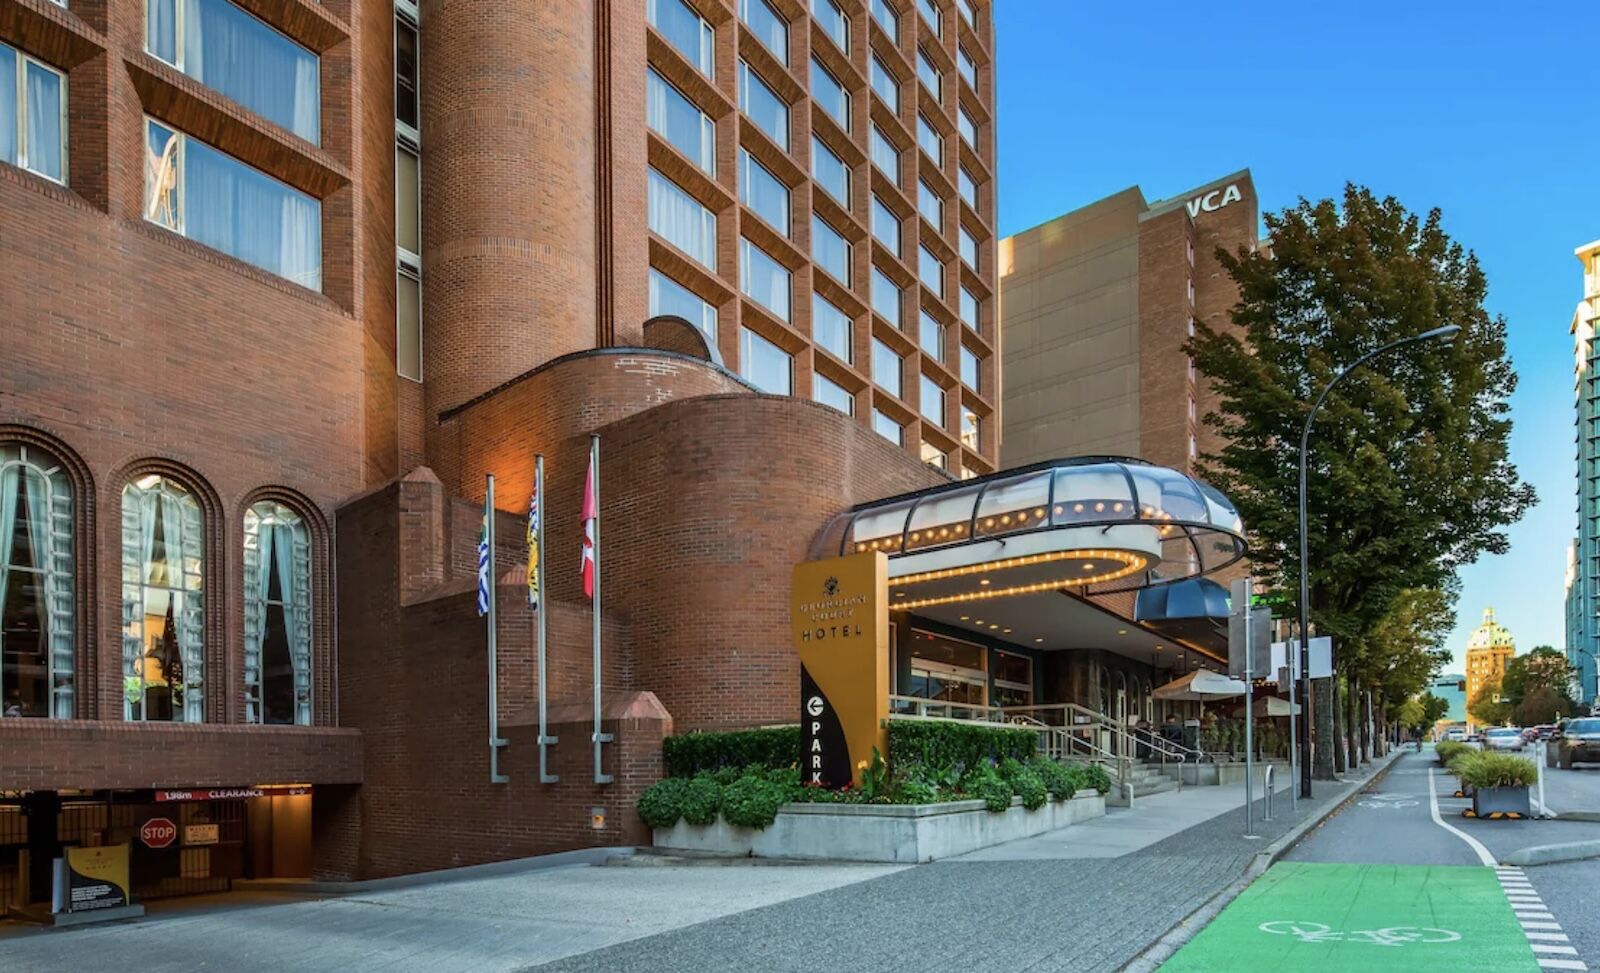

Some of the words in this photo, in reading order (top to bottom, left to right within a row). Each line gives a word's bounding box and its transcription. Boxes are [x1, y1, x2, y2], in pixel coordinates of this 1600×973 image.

[802, 624, 862, 641] HOTEL
[811, 721, 822, 785] PARK
[208, 788, 265, 799] CLEARANCE
[143, 827, 174, 840] STOP
